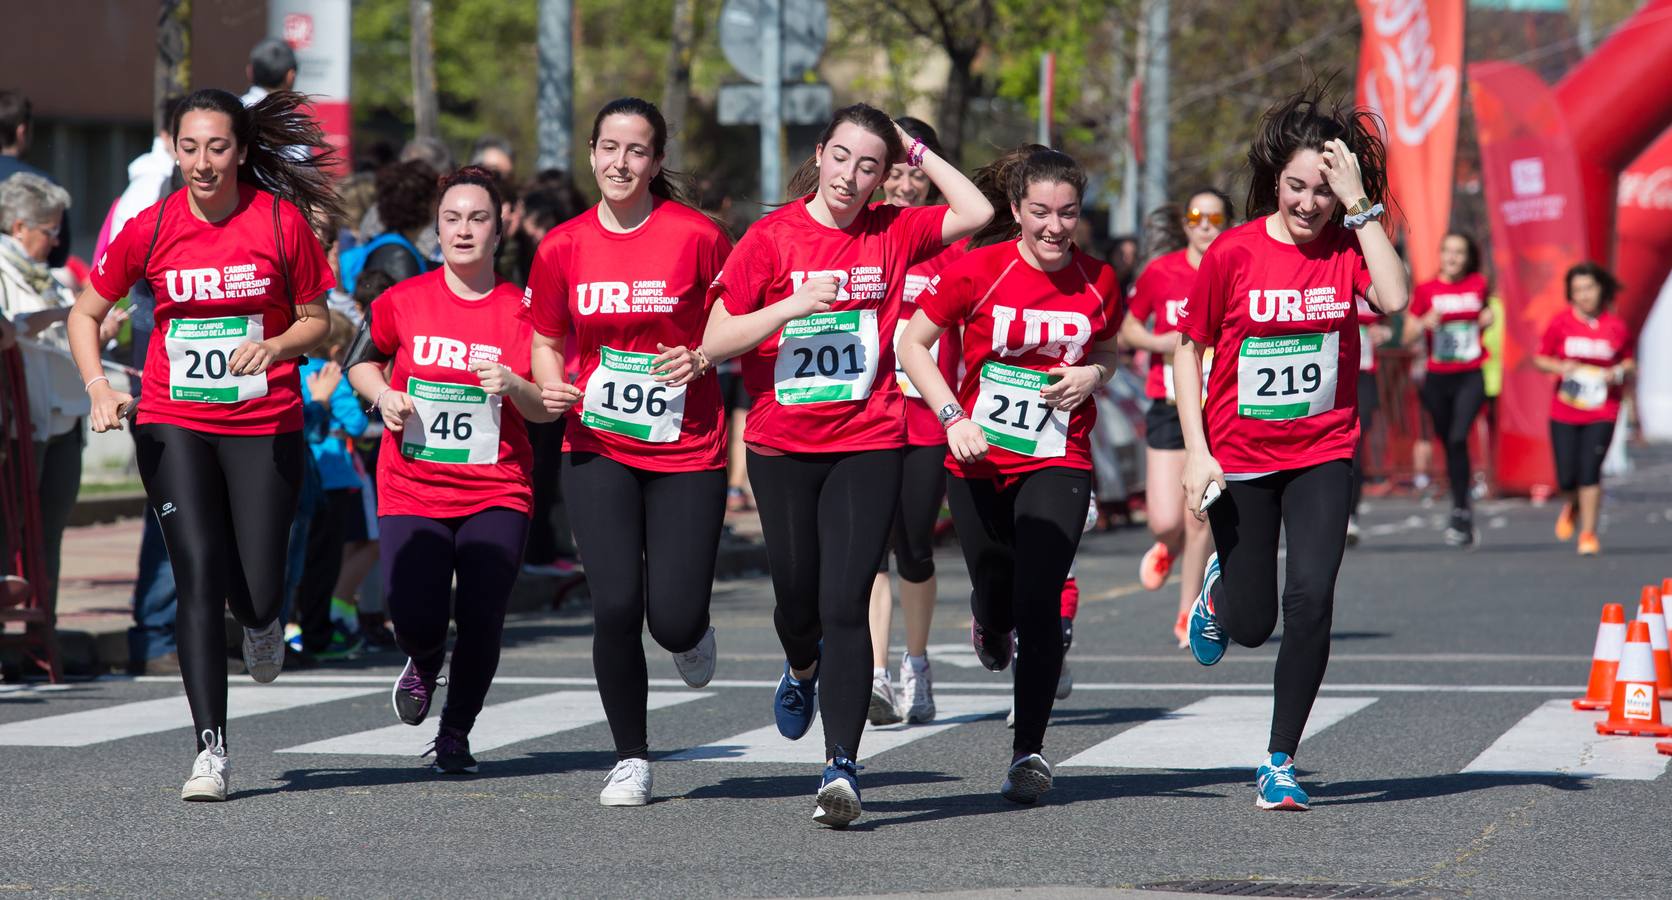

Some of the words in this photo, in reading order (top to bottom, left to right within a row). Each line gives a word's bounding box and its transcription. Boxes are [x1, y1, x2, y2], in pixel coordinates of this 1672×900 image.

[224, 264, 257, 274] CARRERA
[851, 266, 882, 275] CARRERA
[224, 272, 255, 282] CAMPUS
[851, 274, 881, 283] CAMPUS
[165, 268, 224, 302] UR
[225, 278, 271, 290] UNIVERSIDAD
[632, 280, 666, 288] CARRERA
[237, 289, 247, 298] LA
[247, 287, 266, 297] RIOJA
[632, 288, 663, 296] CAMPUS
[851, 292, 861, 300] DE
[1304, 287, 1336, 297] CARRERA
[577, 281, 630, 316] UR
[632, 297, 679, 305] UNIVERSIDAD
[1304, 295, 1334, 305] CAMPUS
[653, 305, 673, 313] RIOJA
[1248, 289, 1305, 322] UR
[1306, 301, 1350, 312] UNIVERSIDAD
[1317, 312, 1326, 320] LA
[1327, 310, 1345, 319] RIOJA
[198, 321, 224, 330] CAMPUS
[811, 317, 836, 325] CAMPUS
[785, 325, 821, 335] NIVERSIDAD
[992, 304, 1092, 365] UR
[1247, 341, 1275, 349] CARRERA
[1275, 338, 1300, 347] CAMPUS
[413, 335, 467, 371] UR
[470, 343, 502, 356] CARRERA
[469, 350, 499, 362] CAMPUS
[623, 356, 649, 365] CAMPUS
[793, 343, 864, 379] 201
[185, 347, 245, 380] 20
[1016, 371, 1041, 382] CAMPUS
[1257, 363, 1322, 396] 219
[441, 387, 465, 395] CAMPUS
[601, 381, 667, 417] 196
[989, 394, 1055, 432] 217
[430, 411, 472, 441] 46
